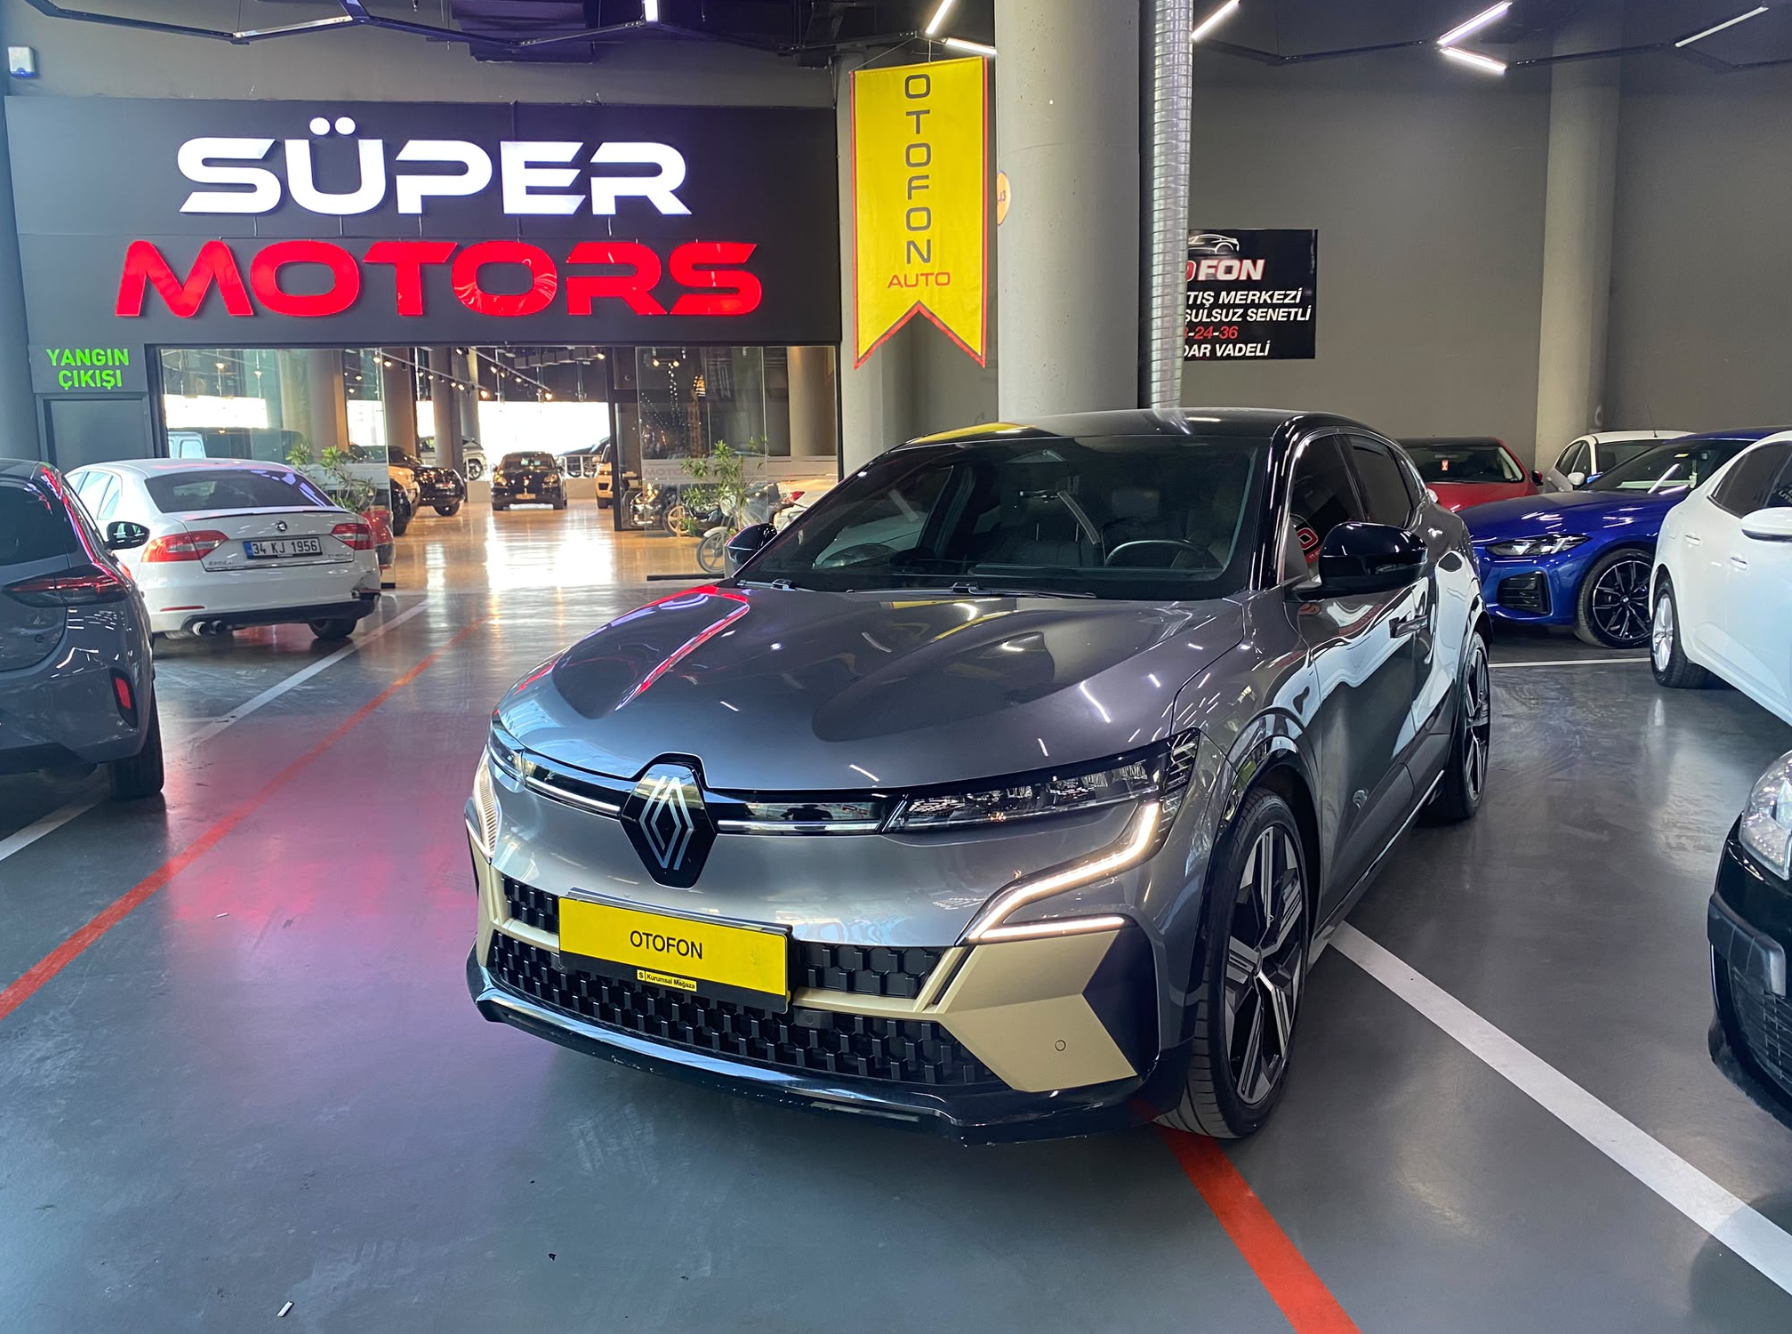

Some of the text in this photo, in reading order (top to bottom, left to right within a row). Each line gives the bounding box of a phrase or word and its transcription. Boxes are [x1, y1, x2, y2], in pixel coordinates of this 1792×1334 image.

[177, 116, 692, 216] SÜPER
[904, 73, 932, 265] OTOFON
[115, 239, 763, 319] MOTORS
[887, 271, 951, 289] AUTO
[1187, 287, 1303, 308] TIŞ MERKEZİ
[1246, 305, 1312, 322] SENETLİ
[46, 348, 130, 367] YANGIN
[1215, 340, 1271, 358] VADELİ
[58, 369, 123, 391] ÇIKIŞI
[252, 540, 318, 555] 34 KJ 1956
[629, 930, 703, 960] OTOFON
[646, 974, 672, 984] Kurumsal
